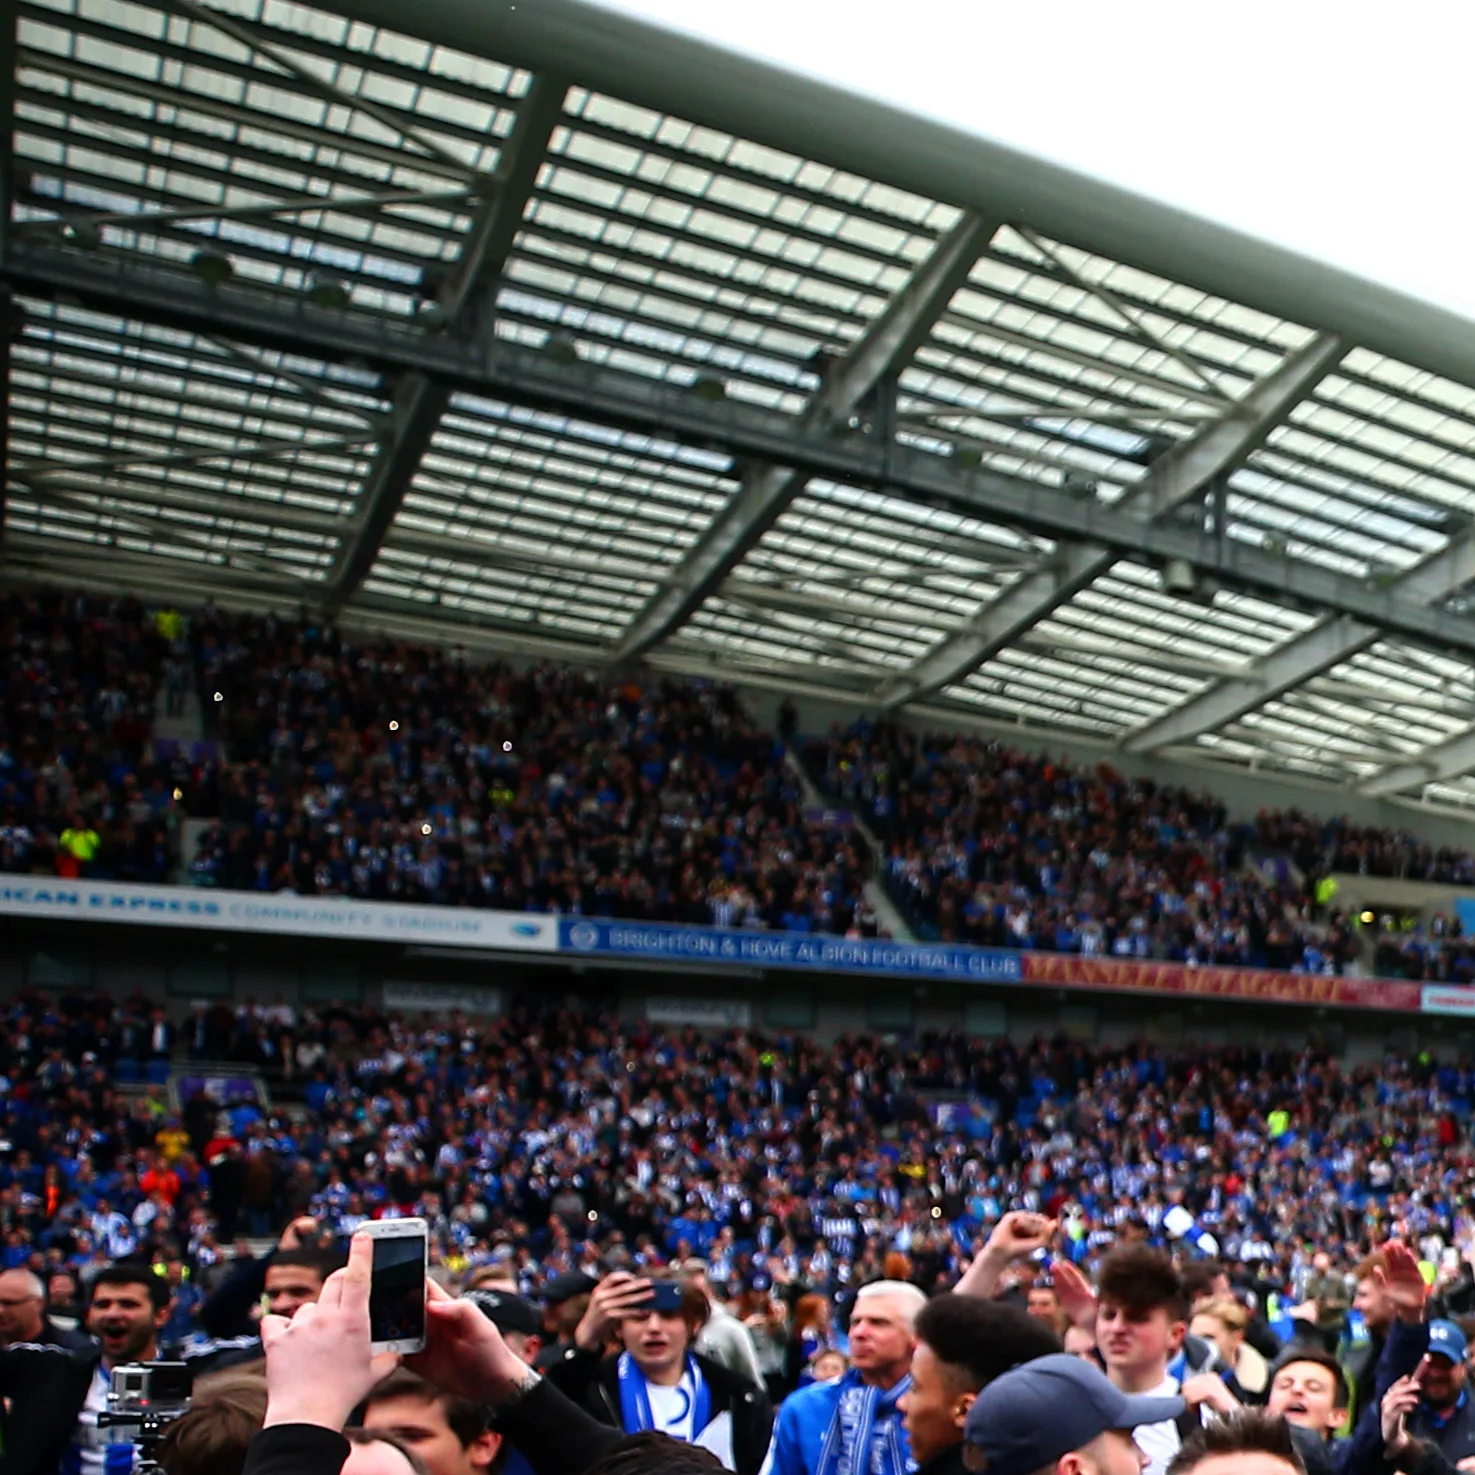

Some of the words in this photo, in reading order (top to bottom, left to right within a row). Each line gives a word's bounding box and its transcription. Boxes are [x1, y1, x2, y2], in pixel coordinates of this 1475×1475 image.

[0, 886, 78, 906] ICAN
[89, 893, 220, 916] EXPRESS
[229, 902, 371, 926] COMMUNITY
[608, 927, 715, 955] BRIGHTON
[720, 938, 736, 956] &
[741, 940, 791, 958] HOVE
[795, 943, 867, 965] ALBION
[872, 948, 965, 972] FOOTBALL
[968, 956, 1017, 974] CLUB
